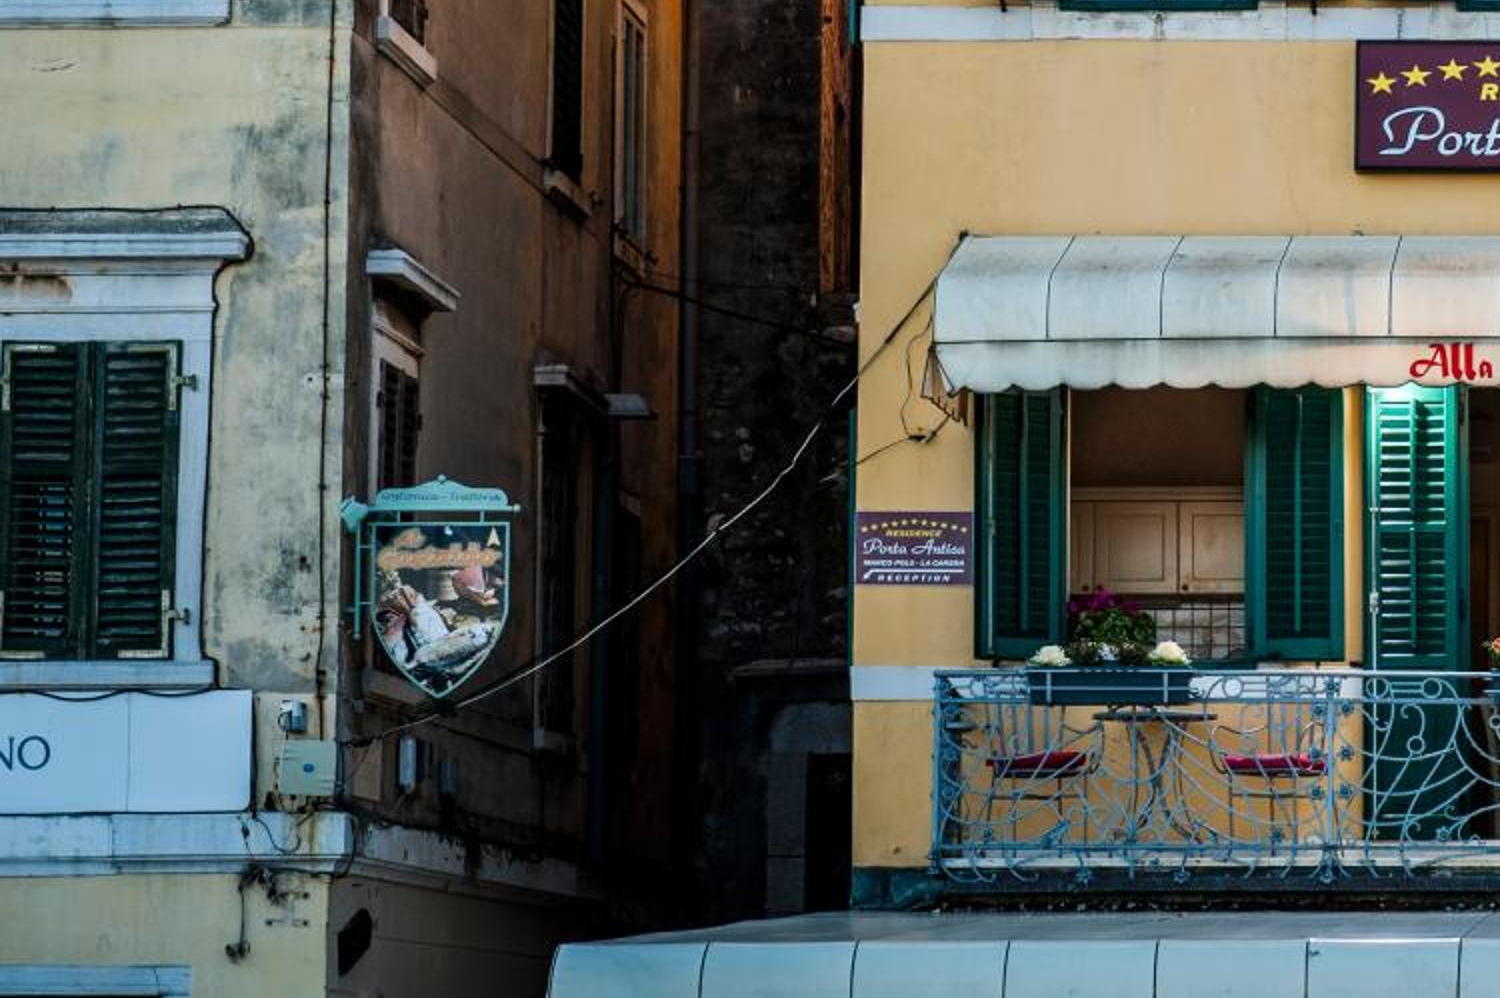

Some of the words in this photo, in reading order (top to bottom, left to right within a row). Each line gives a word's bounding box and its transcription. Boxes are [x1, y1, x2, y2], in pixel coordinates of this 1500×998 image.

[1409, 342, 1493, 380] Alla
[886, 529, 943, 537] RESIDENCE
[863, 538, 907, 554] Porta
[911, 539, 965, 556] Antica
[877, 574, 951, 582] RECEPTION
